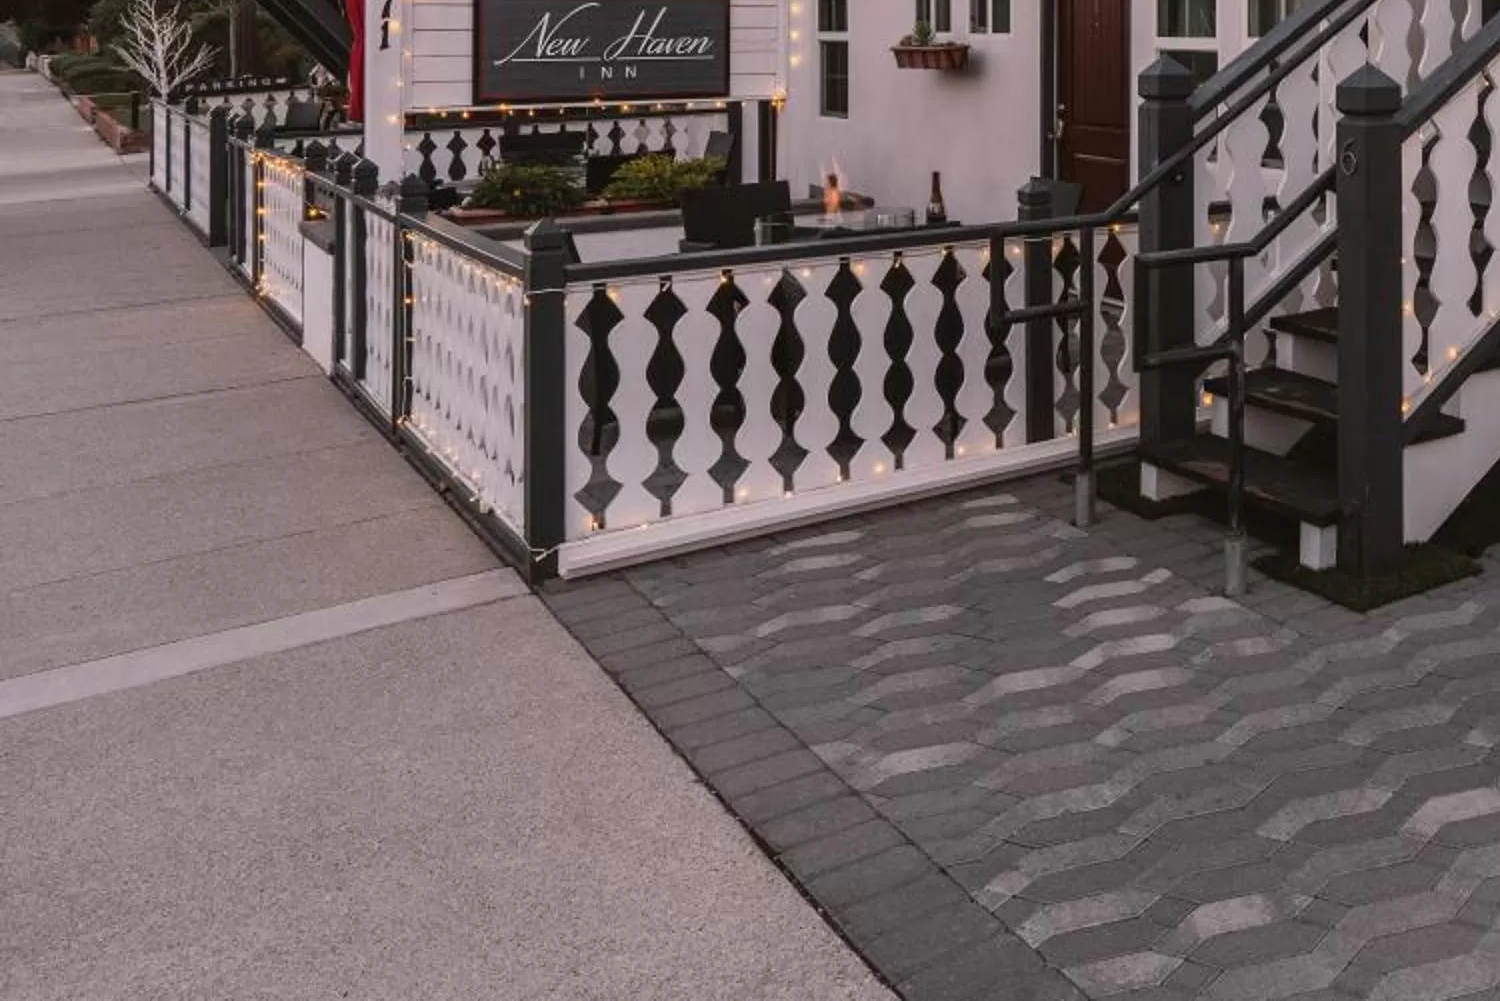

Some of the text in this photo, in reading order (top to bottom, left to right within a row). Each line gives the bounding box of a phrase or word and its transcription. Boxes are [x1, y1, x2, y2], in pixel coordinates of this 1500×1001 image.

[493, 2, 714, 66] New Haven
[184, 77, 272, 92] PARKING
[579, 64, 638, 80] INN
[1340, 137, 1358, 177] 6
